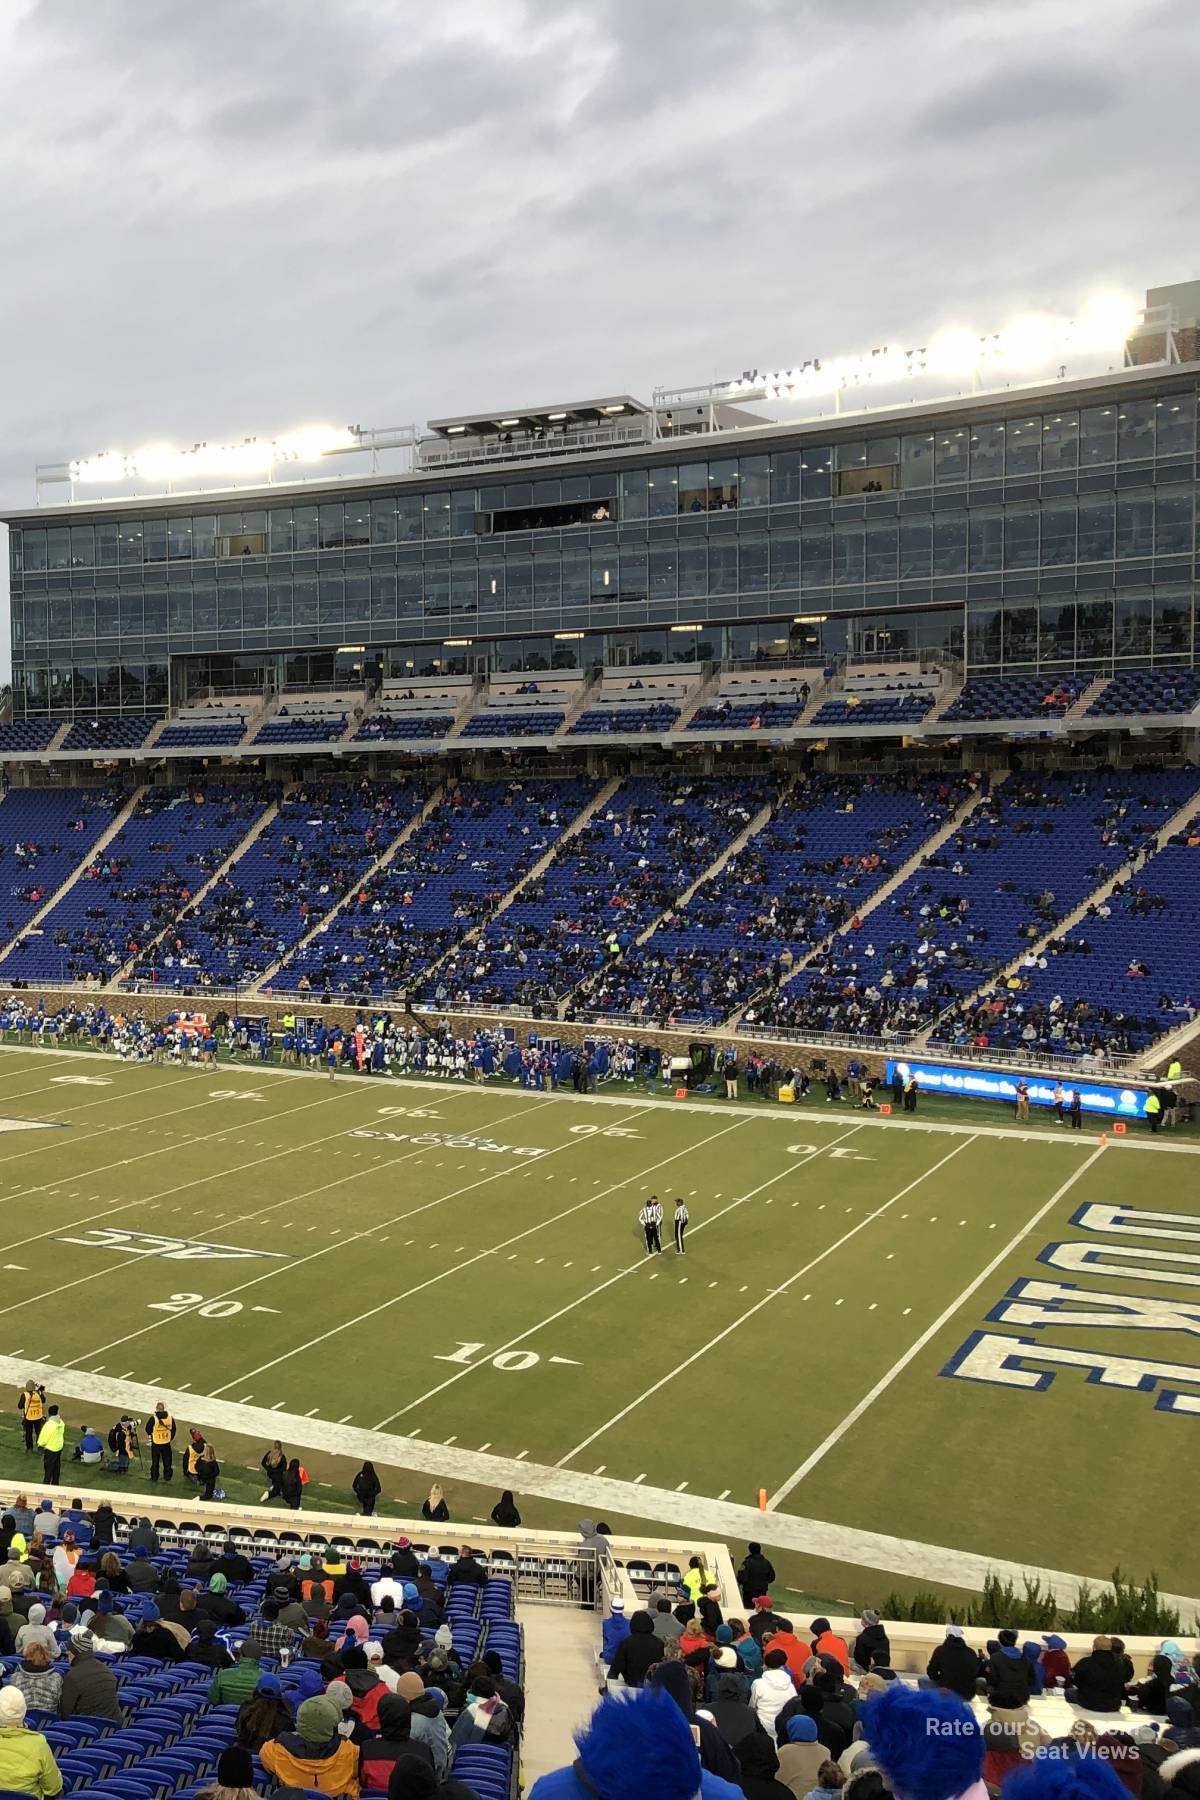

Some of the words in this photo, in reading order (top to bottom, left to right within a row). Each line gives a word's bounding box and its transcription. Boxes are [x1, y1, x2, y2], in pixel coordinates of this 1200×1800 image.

[569, 1124, 641, 1138] 20
[348, 1128, 548, 1157] BROOKS
[786, 1144, 861, 1159] 10
[147, 1292, 244, 1318] 20
[432, 1341, 541, 1371] 10
[157, 1432, 171, 1440] 154
